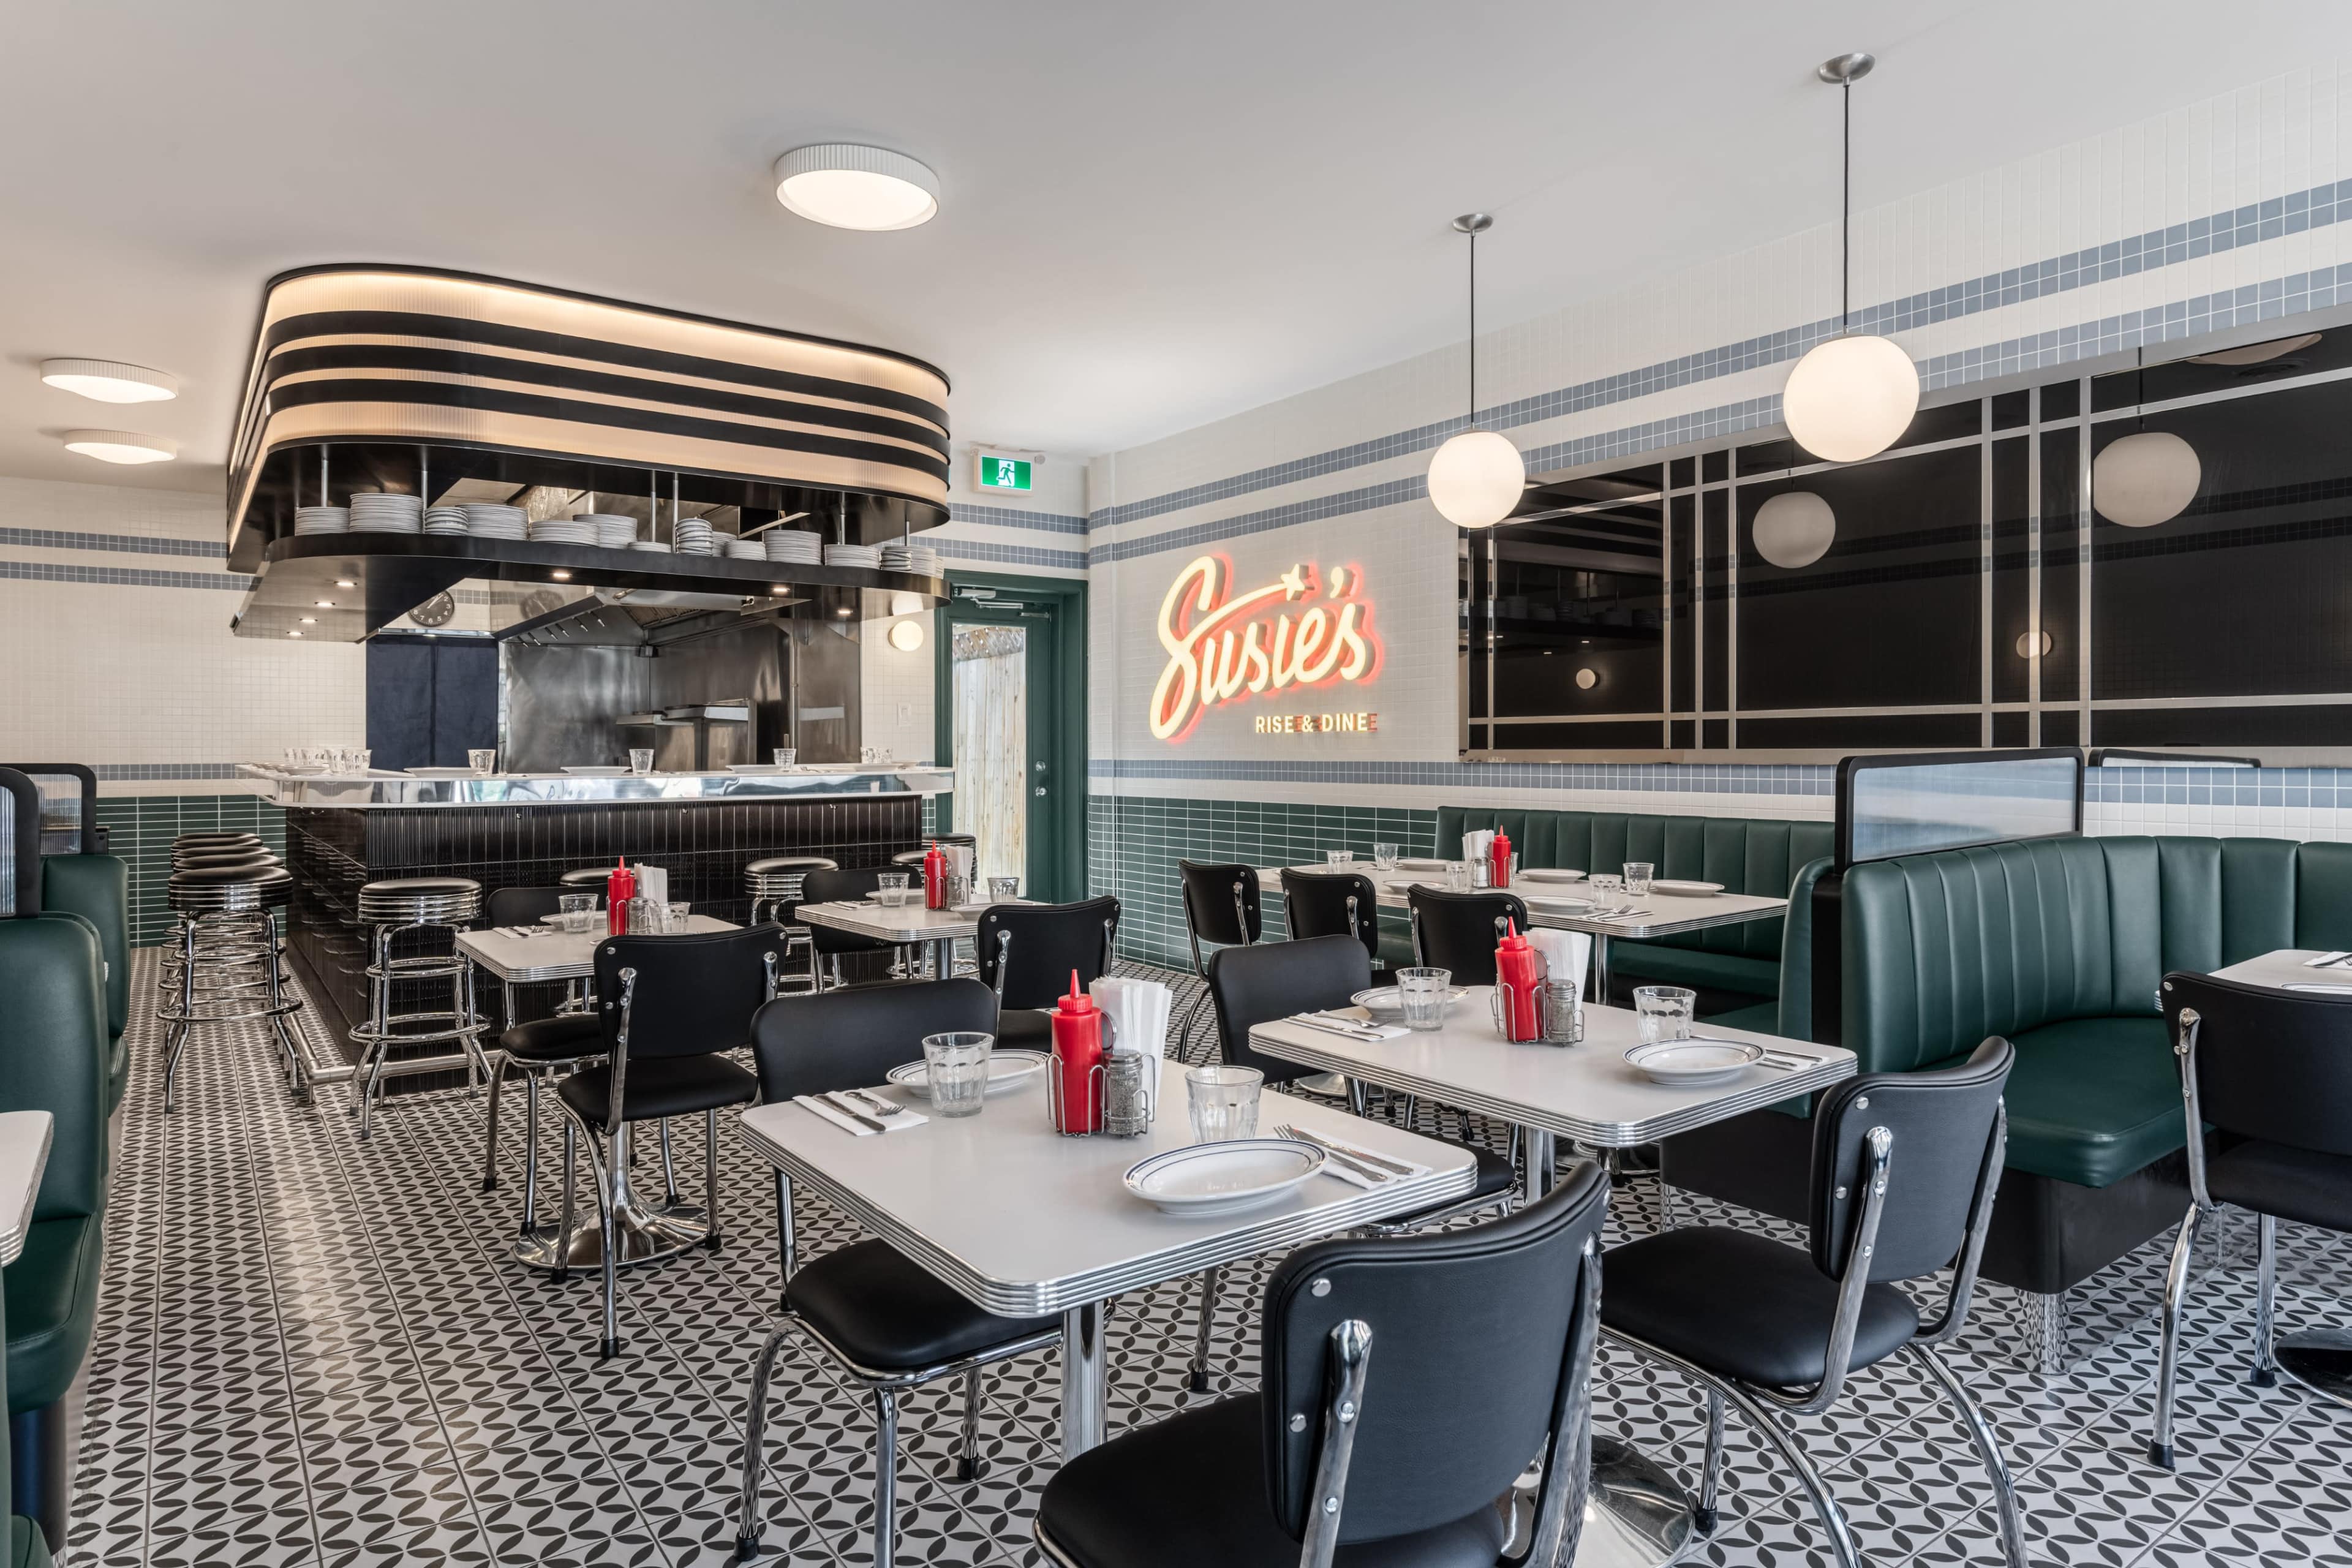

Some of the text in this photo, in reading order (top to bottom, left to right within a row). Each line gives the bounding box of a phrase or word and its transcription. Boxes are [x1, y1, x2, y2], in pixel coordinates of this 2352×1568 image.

[1149, 556, 1367, 740] Susie's
[1255, 712, 1368, 733] RISE & DINE
